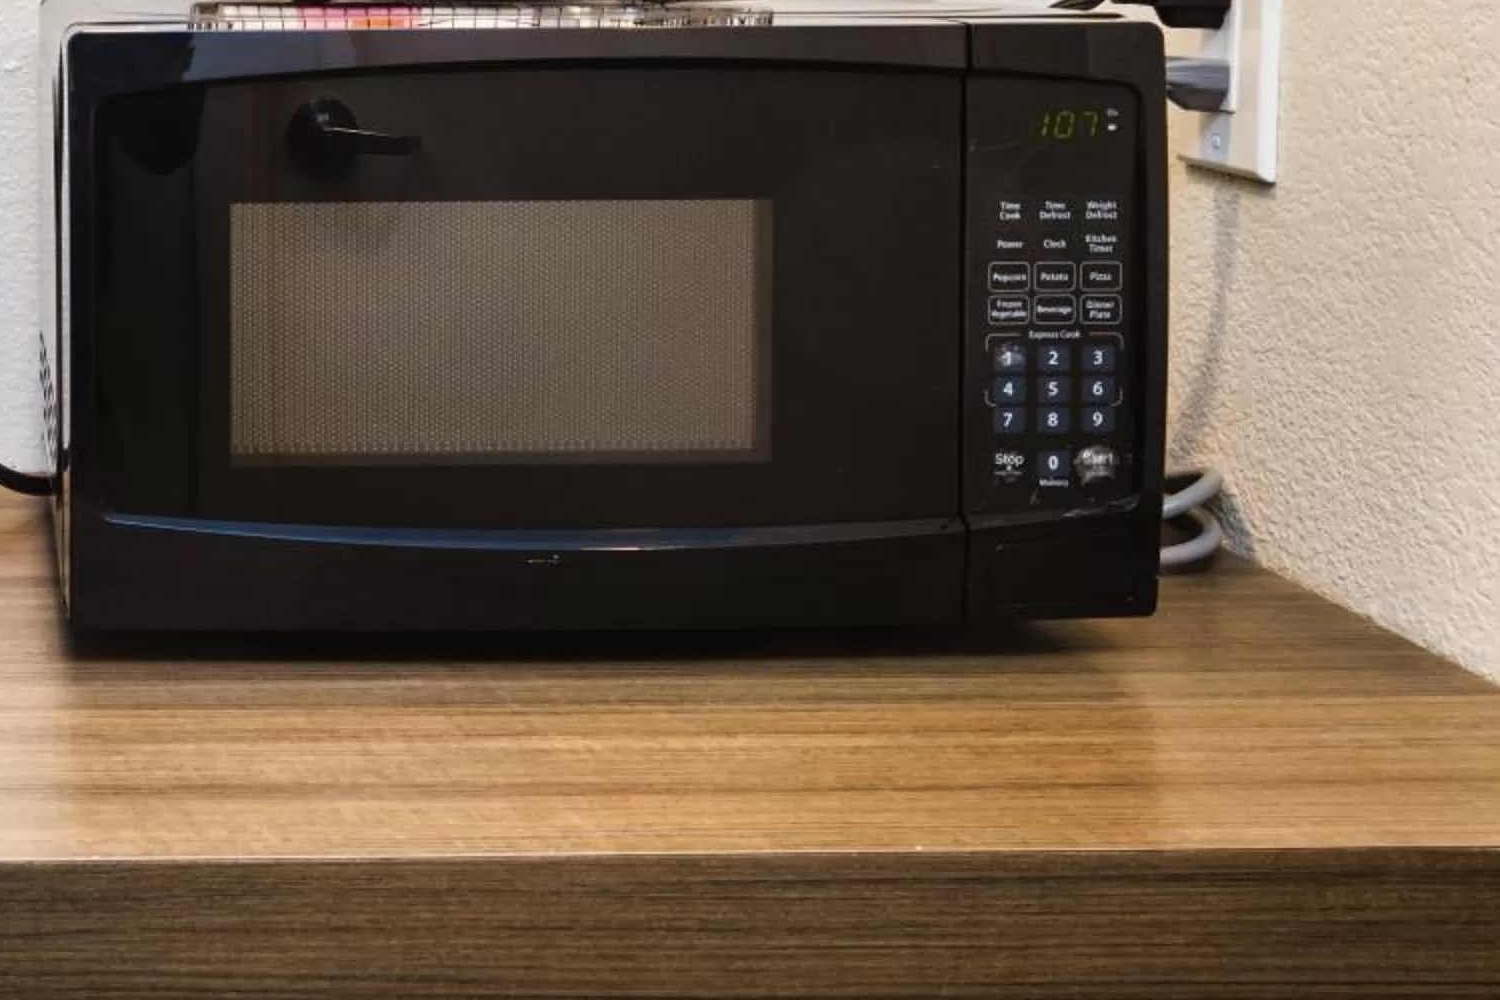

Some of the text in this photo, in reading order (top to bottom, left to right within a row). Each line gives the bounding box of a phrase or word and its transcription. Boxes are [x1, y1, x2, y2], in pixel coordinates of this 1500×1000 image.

[1048, 351, 1059, 366] 2
[1093, 351, 1104, 366] 3
[1003, 382, 1014, 396] 4
[1048, 381, 1059, 395] 5
[1093, 381, 1104, 395] 6
[1003, 412, 1013, 427] 7
[1047, 412, 1059, 427] 8
[1092, 412, 1103, 427] 9
[995, 453, 1025, 466] Stop
[1048, 456, 1059, 470] 0
